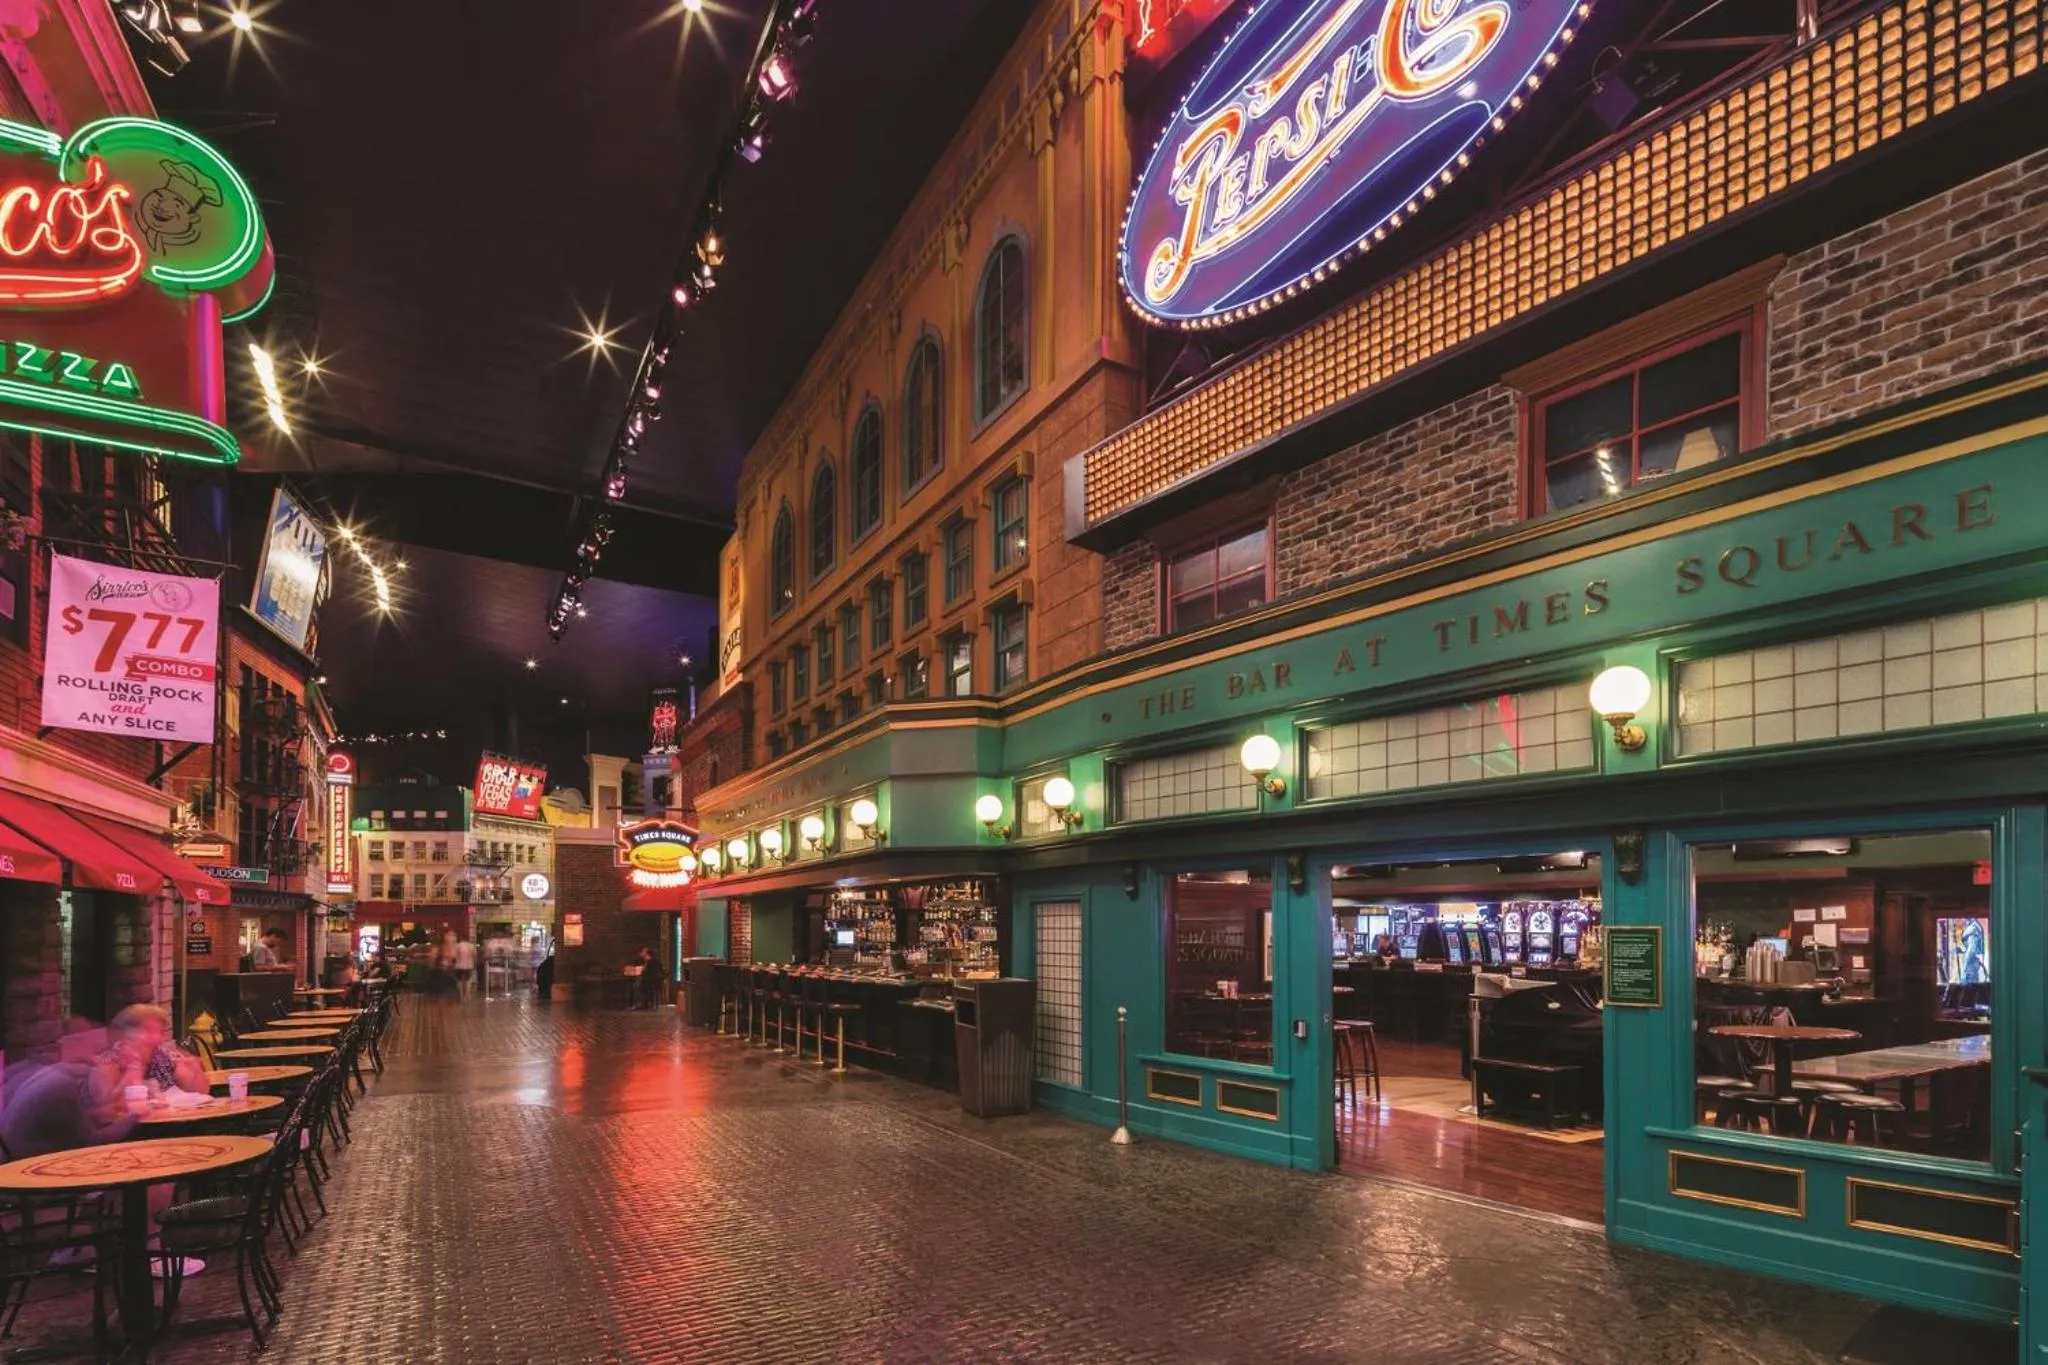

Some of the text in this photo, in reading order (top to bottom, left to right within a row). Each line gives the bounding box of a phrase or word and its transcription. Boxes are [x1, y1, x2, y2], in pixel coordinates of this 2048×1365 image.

[1138, 483, 1999, 720] THE BAR AT TIMES SQUARE
[136, 659, 204, 678] COMBO
[57, 675, 203, 702] ROLLING ROCK
[108, 693, 154, 704] DRAFT
[111, 704, 147, 715] and
[78, 712, 176, 732] ANY SLICE
[482, 763, 517, 786] GRAB
[480, 782, 513, 801] VEGAS
[634, 831, 692, 844] TIMES SQUARE
